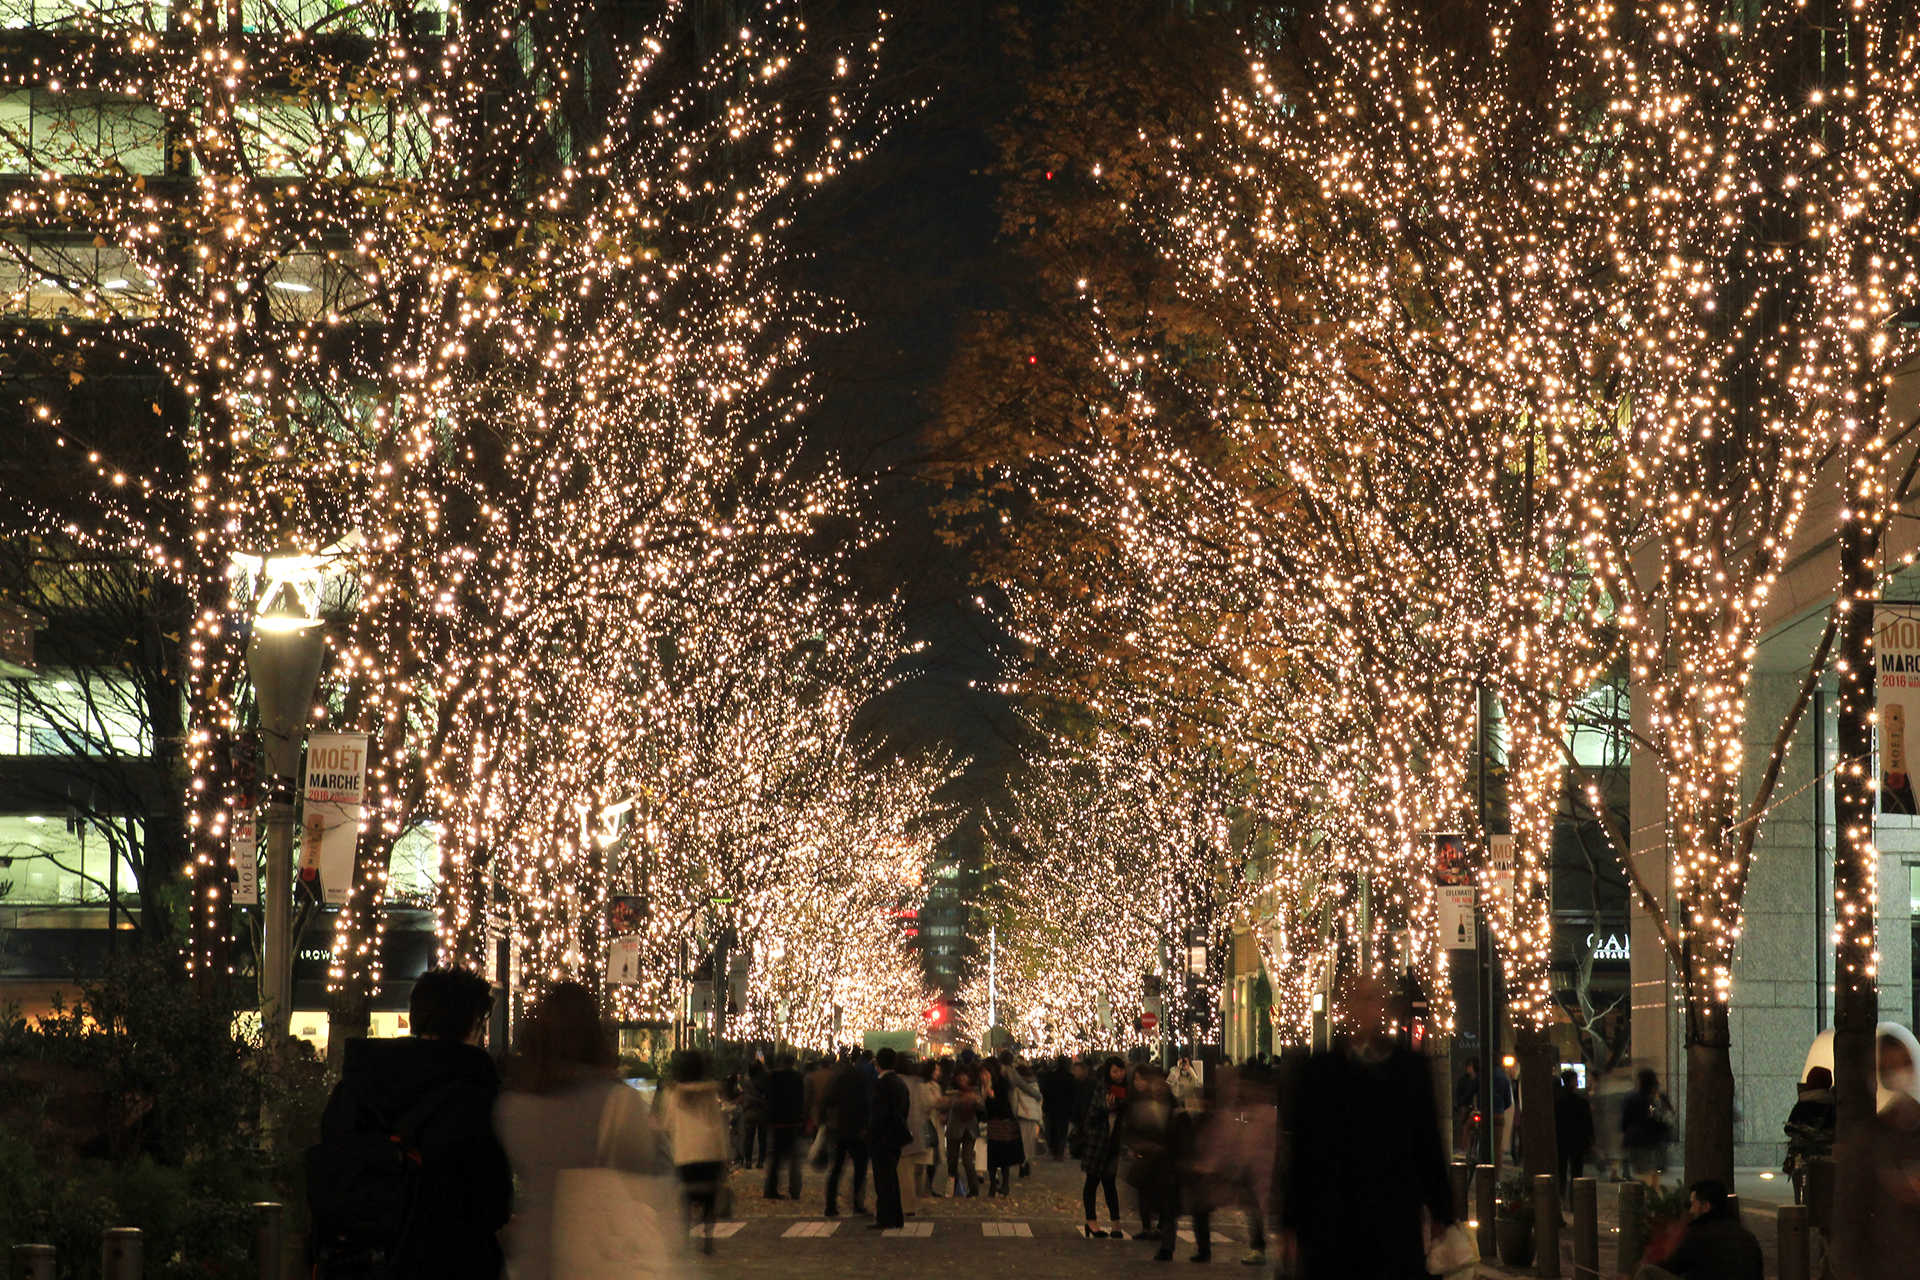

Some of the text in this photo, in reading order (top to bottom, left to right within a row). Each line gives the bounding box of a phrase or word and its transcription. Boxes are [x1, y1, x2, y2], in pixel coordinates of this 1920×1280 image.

[1882, 674, 1907, 688] 2016
[310, 744, 363, 771] MOËT
[309, 772, 361, 790] MARCHÉ
[308, 789, 329, 801] 2016
